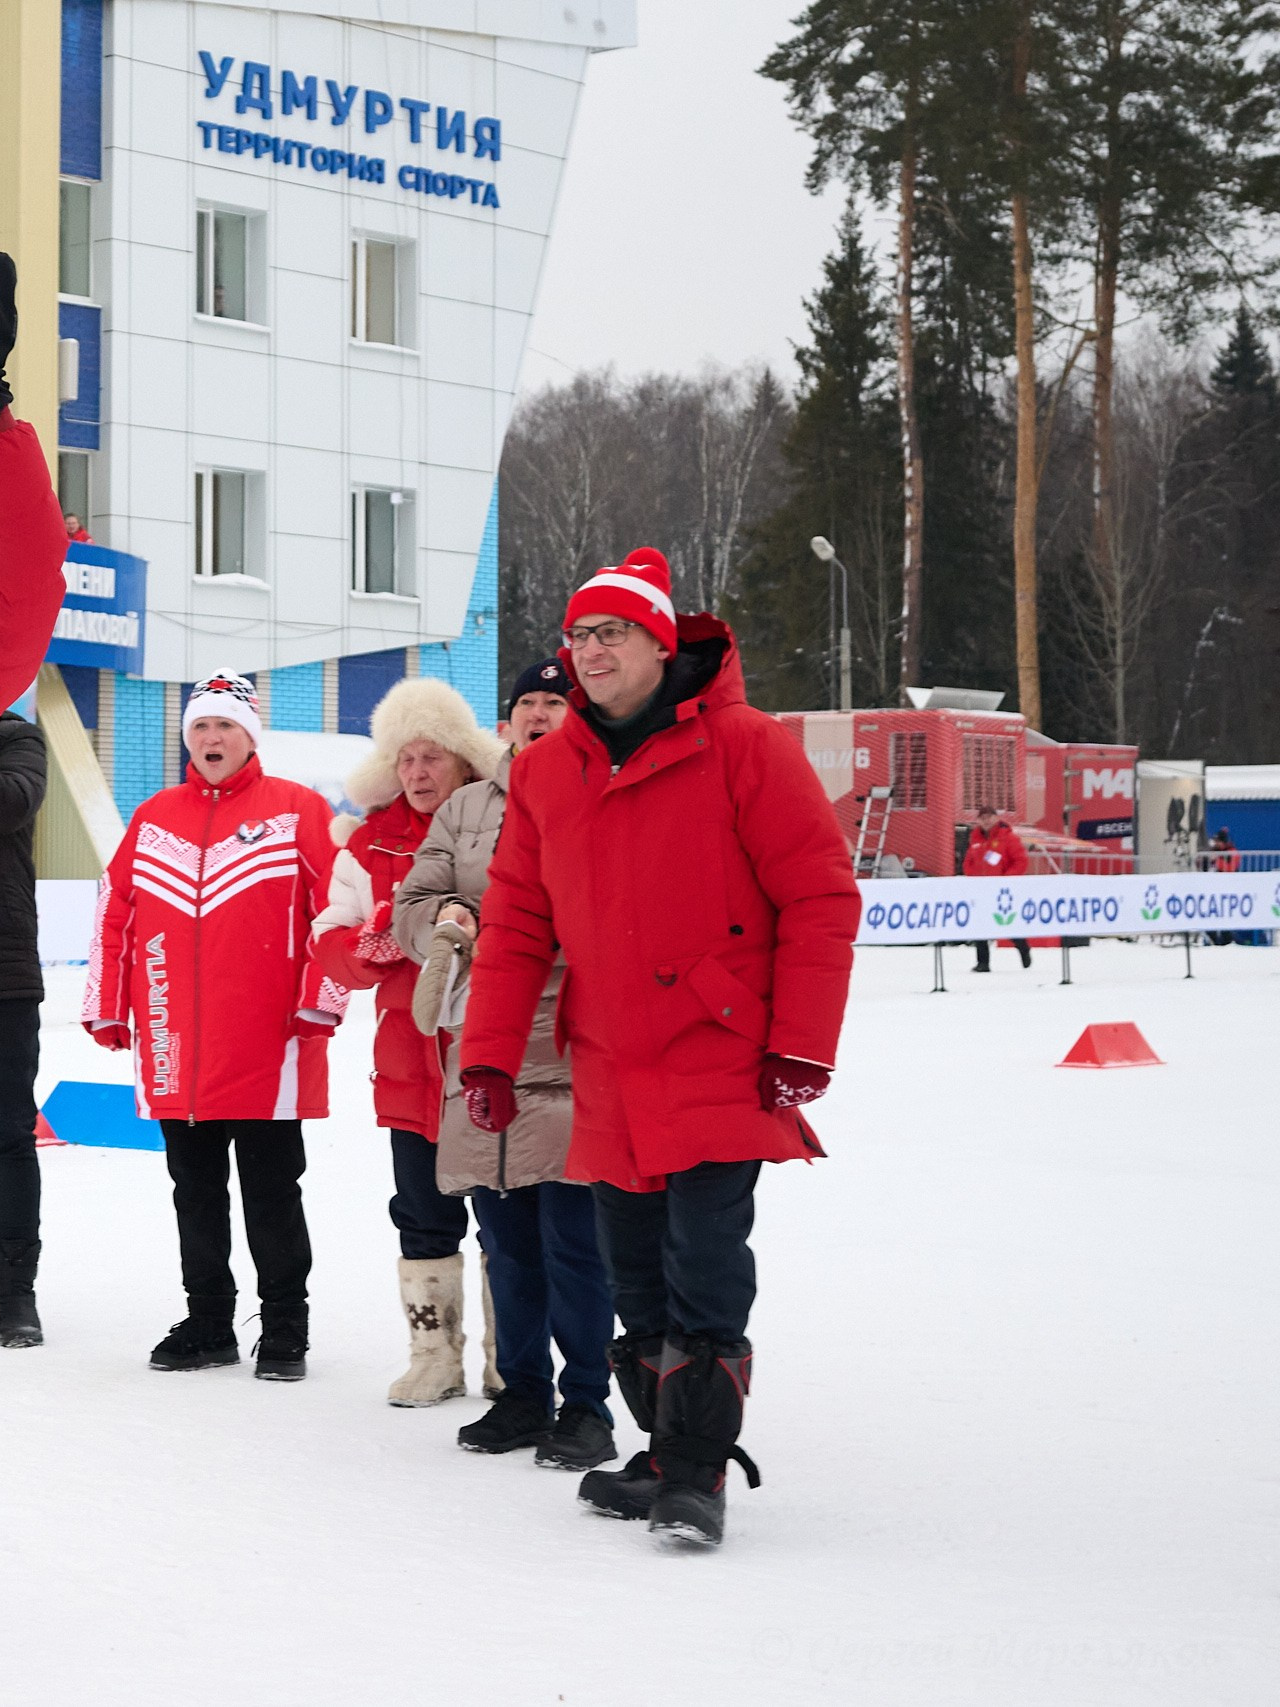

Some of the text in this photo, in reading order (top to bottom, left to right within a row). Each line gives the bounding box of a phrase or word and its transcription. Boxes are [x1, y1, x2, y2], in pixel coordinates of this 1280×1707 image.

[198, 49, 502, 162] УДМУРТИЯ
[197, 120, 501, 209] ТЕРРИТОРИЯ СПОРТА
[61, 561, 116, 600] МЕНИ
[51, 608, 139, 648] ЛАКОВОЙ
[1082, 767, 1134, 799] МА
[1097, 822, 1133, 834] #ВСЕН
[866, 900, 971, 931] ФОСАГРО
[1021, 896, 1120, 925] ФОСАГРО
[1166, 892, 1254, 920] ФОСАГРО
[146, 932, 170, 1096] UDMURTIA
